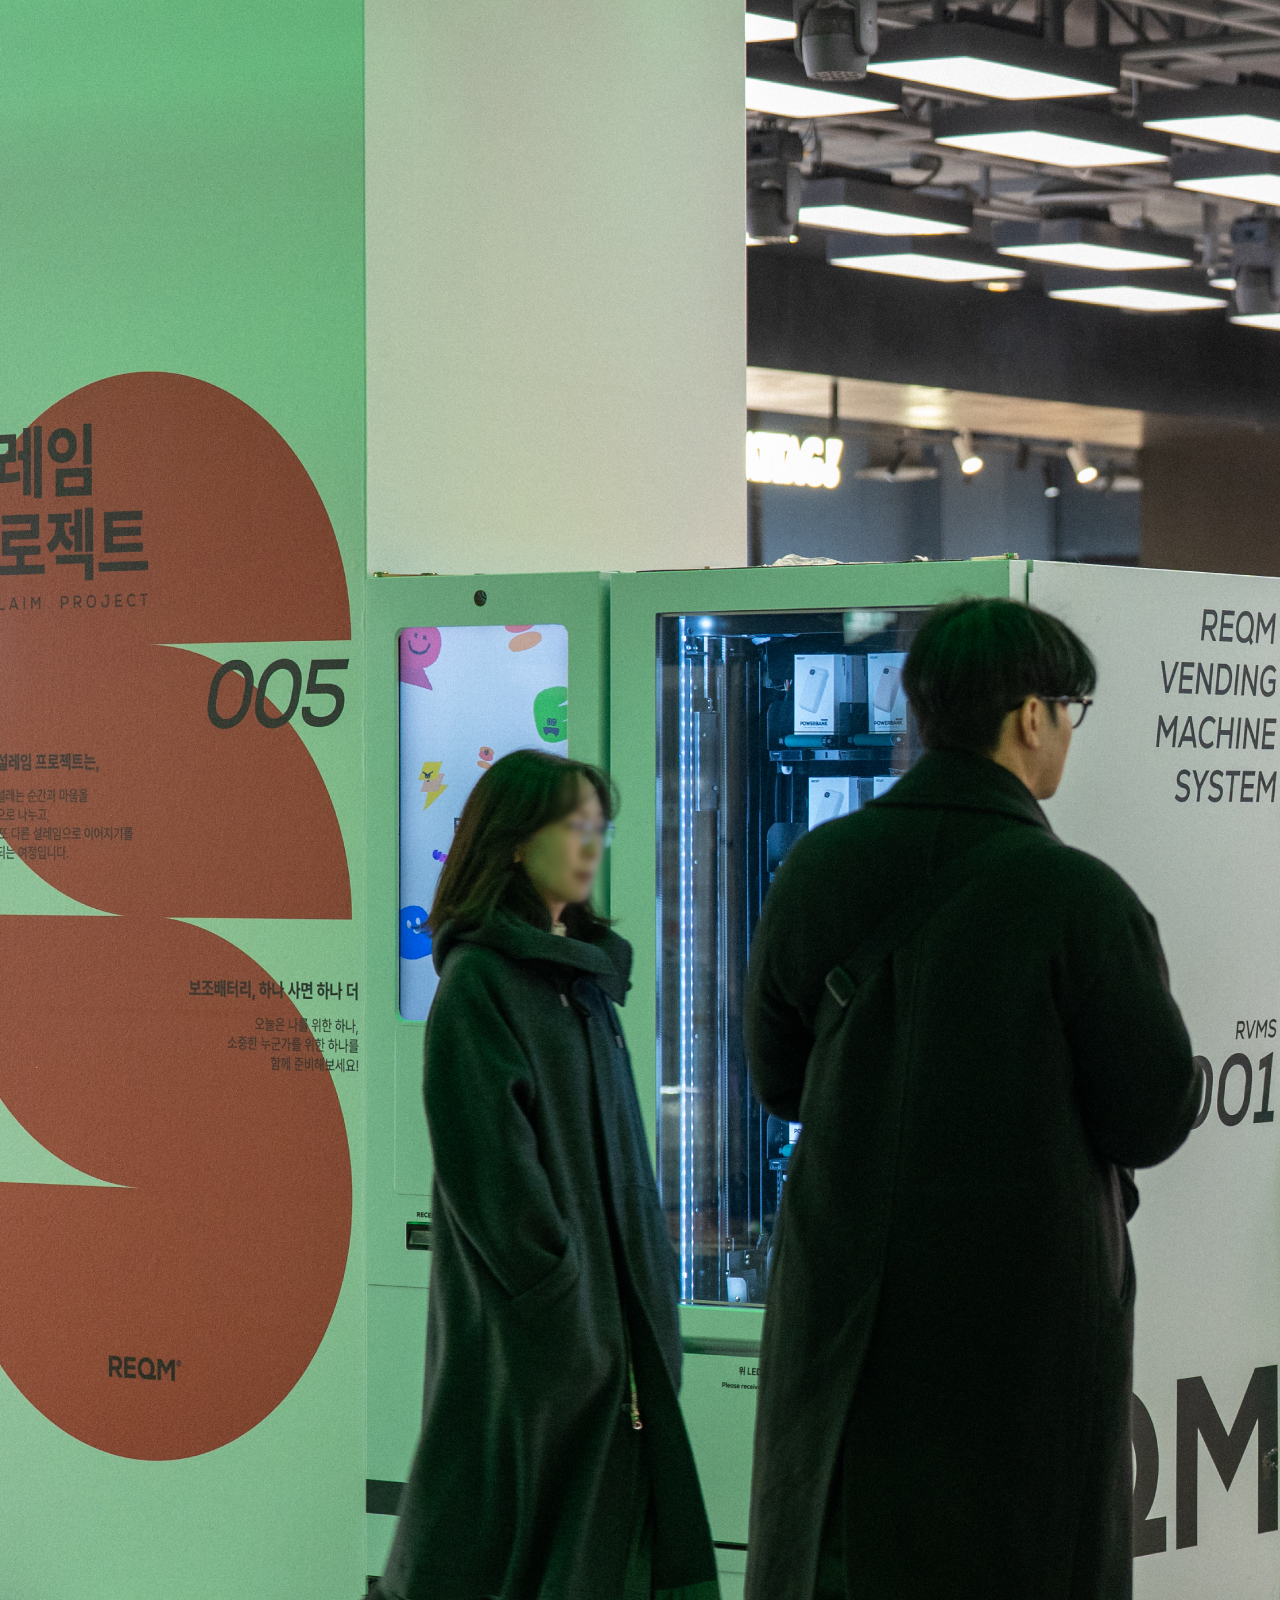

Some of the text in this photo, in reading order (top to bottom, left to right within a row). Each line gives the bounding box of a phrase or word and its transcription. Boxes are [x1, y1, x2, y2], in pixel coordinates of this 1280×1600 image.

[0, 507, 149, 581] 로젝트
[0, 593, 149, 611] AIM PROJECT
[1201, 609, 1277, 645] REQM
[1160, 660, 1277, 698] VENDING
[207, 658, 349, 730] 005
[1155, 714, 1277, 750] MACHINE
[35, 753, 100, 772] 프로젝트는,
[1174, 768, 1277, 803] SYSTEM
[11, 827, 30, 841] 다른
[17, 845, 69, 861] 여정입니다.
[189, 979, 360, 1001] 보조배터리, 하나 사면 하나 더
[254, 1017, 286, 1033] 오늘은
[311, 1018, 333, 1034] 위한
[1235, 1018, 1277, 1040] RVMS
[227, 1036, 258, 1052] 소중한
[304, 1037, 325, 1053] 위한
[327, 1038, 360, 1054] 하나를
[270, 1056, 292, 1073] 함께
